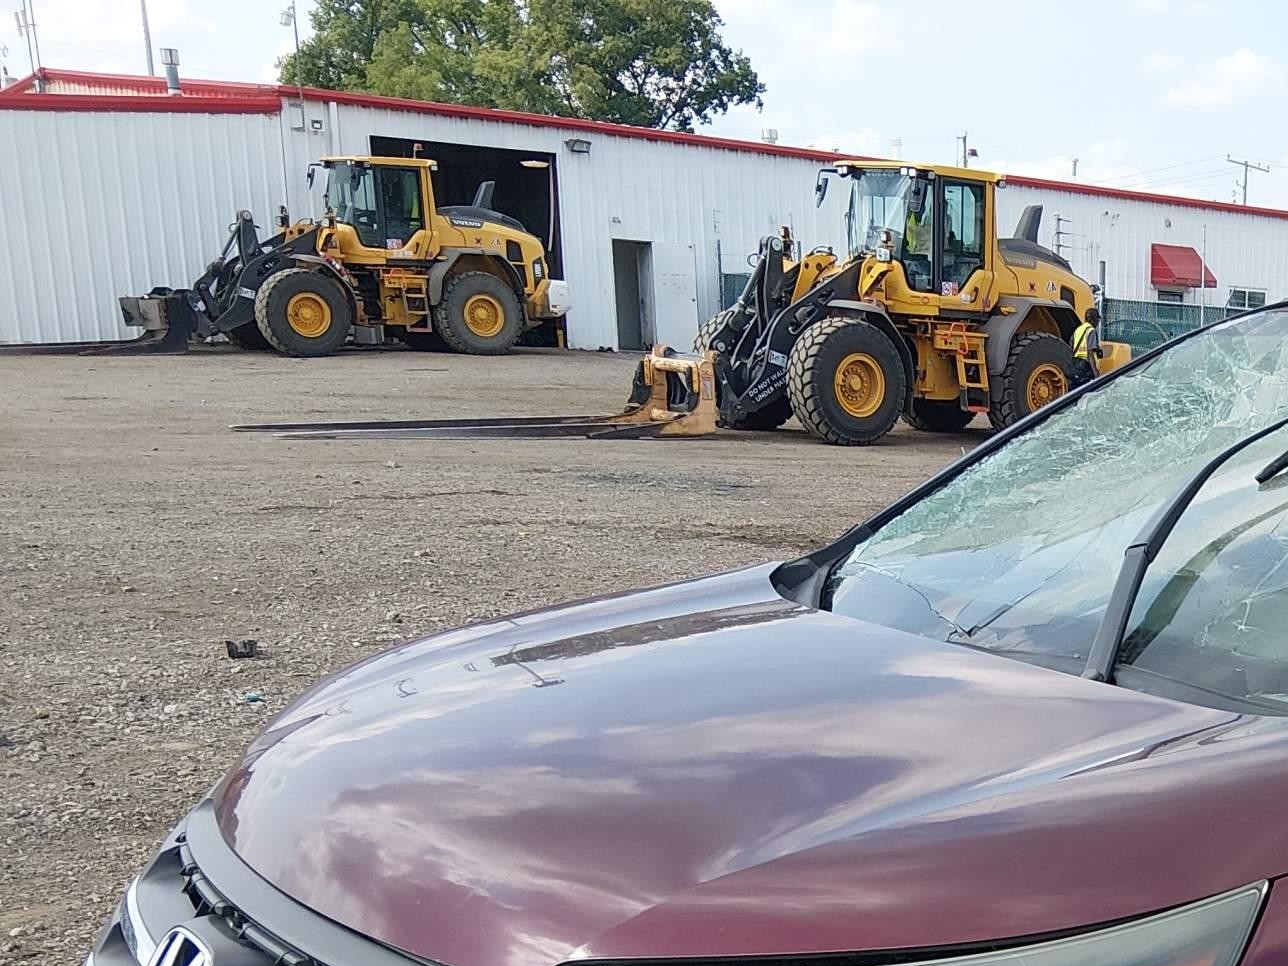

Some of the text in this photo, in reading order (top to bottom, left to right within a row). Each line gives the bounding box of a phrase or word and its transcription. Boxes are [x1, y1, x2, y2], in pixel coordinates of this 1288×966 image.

[453, 219, 482, 227] VOLVO
[748, 387, 759, 397] DO
[757, 378, 771, 391] NOT
